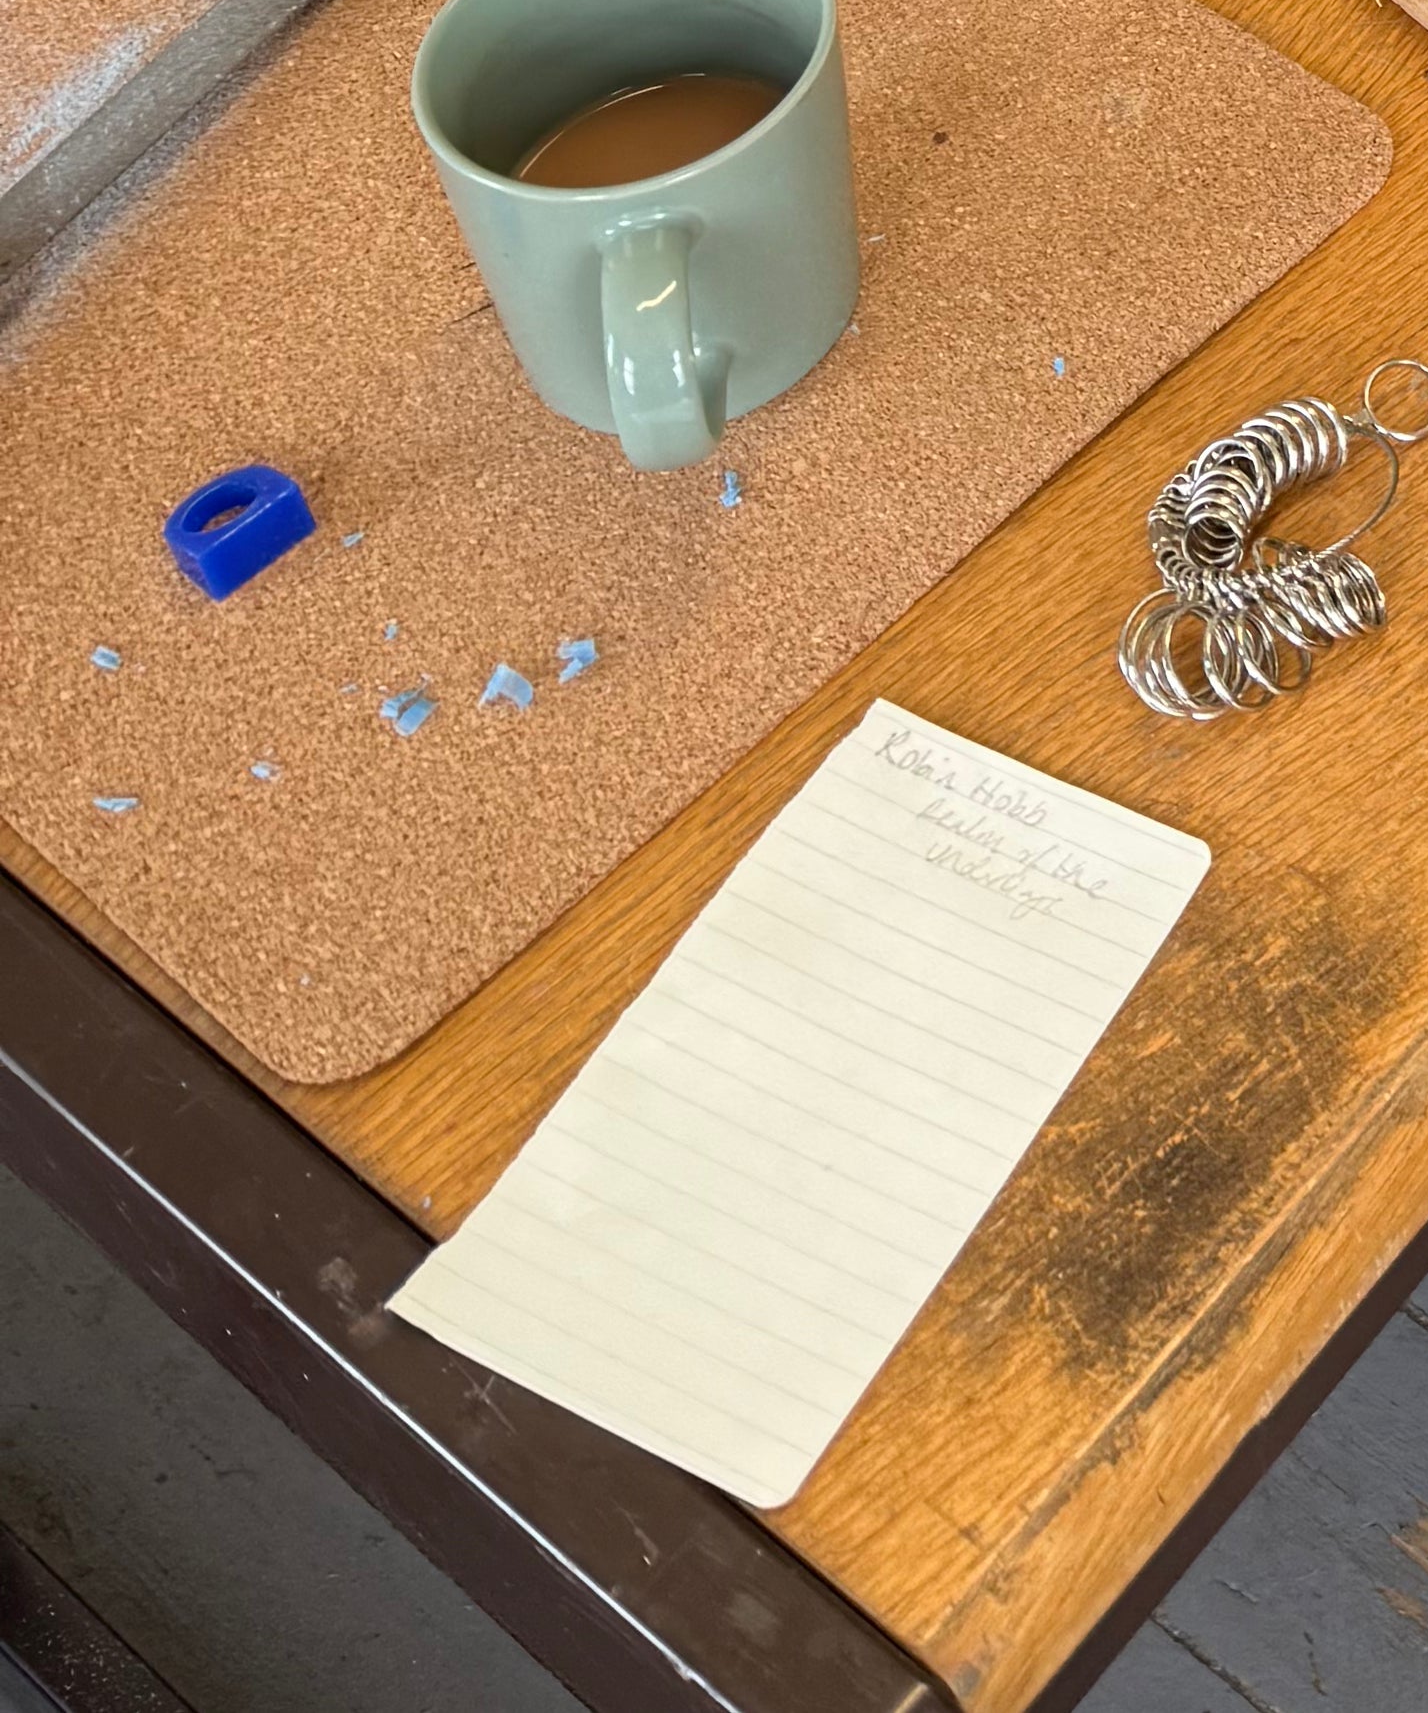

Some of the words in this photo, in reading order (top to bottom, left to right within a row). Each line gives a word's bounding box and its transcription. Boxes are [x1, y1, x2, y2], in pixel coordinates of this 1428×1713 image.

[969, 777, 1047, 826] Hobb
[1017, 844, 1058, 876] of
[1052, 853, 1108, 898] the
